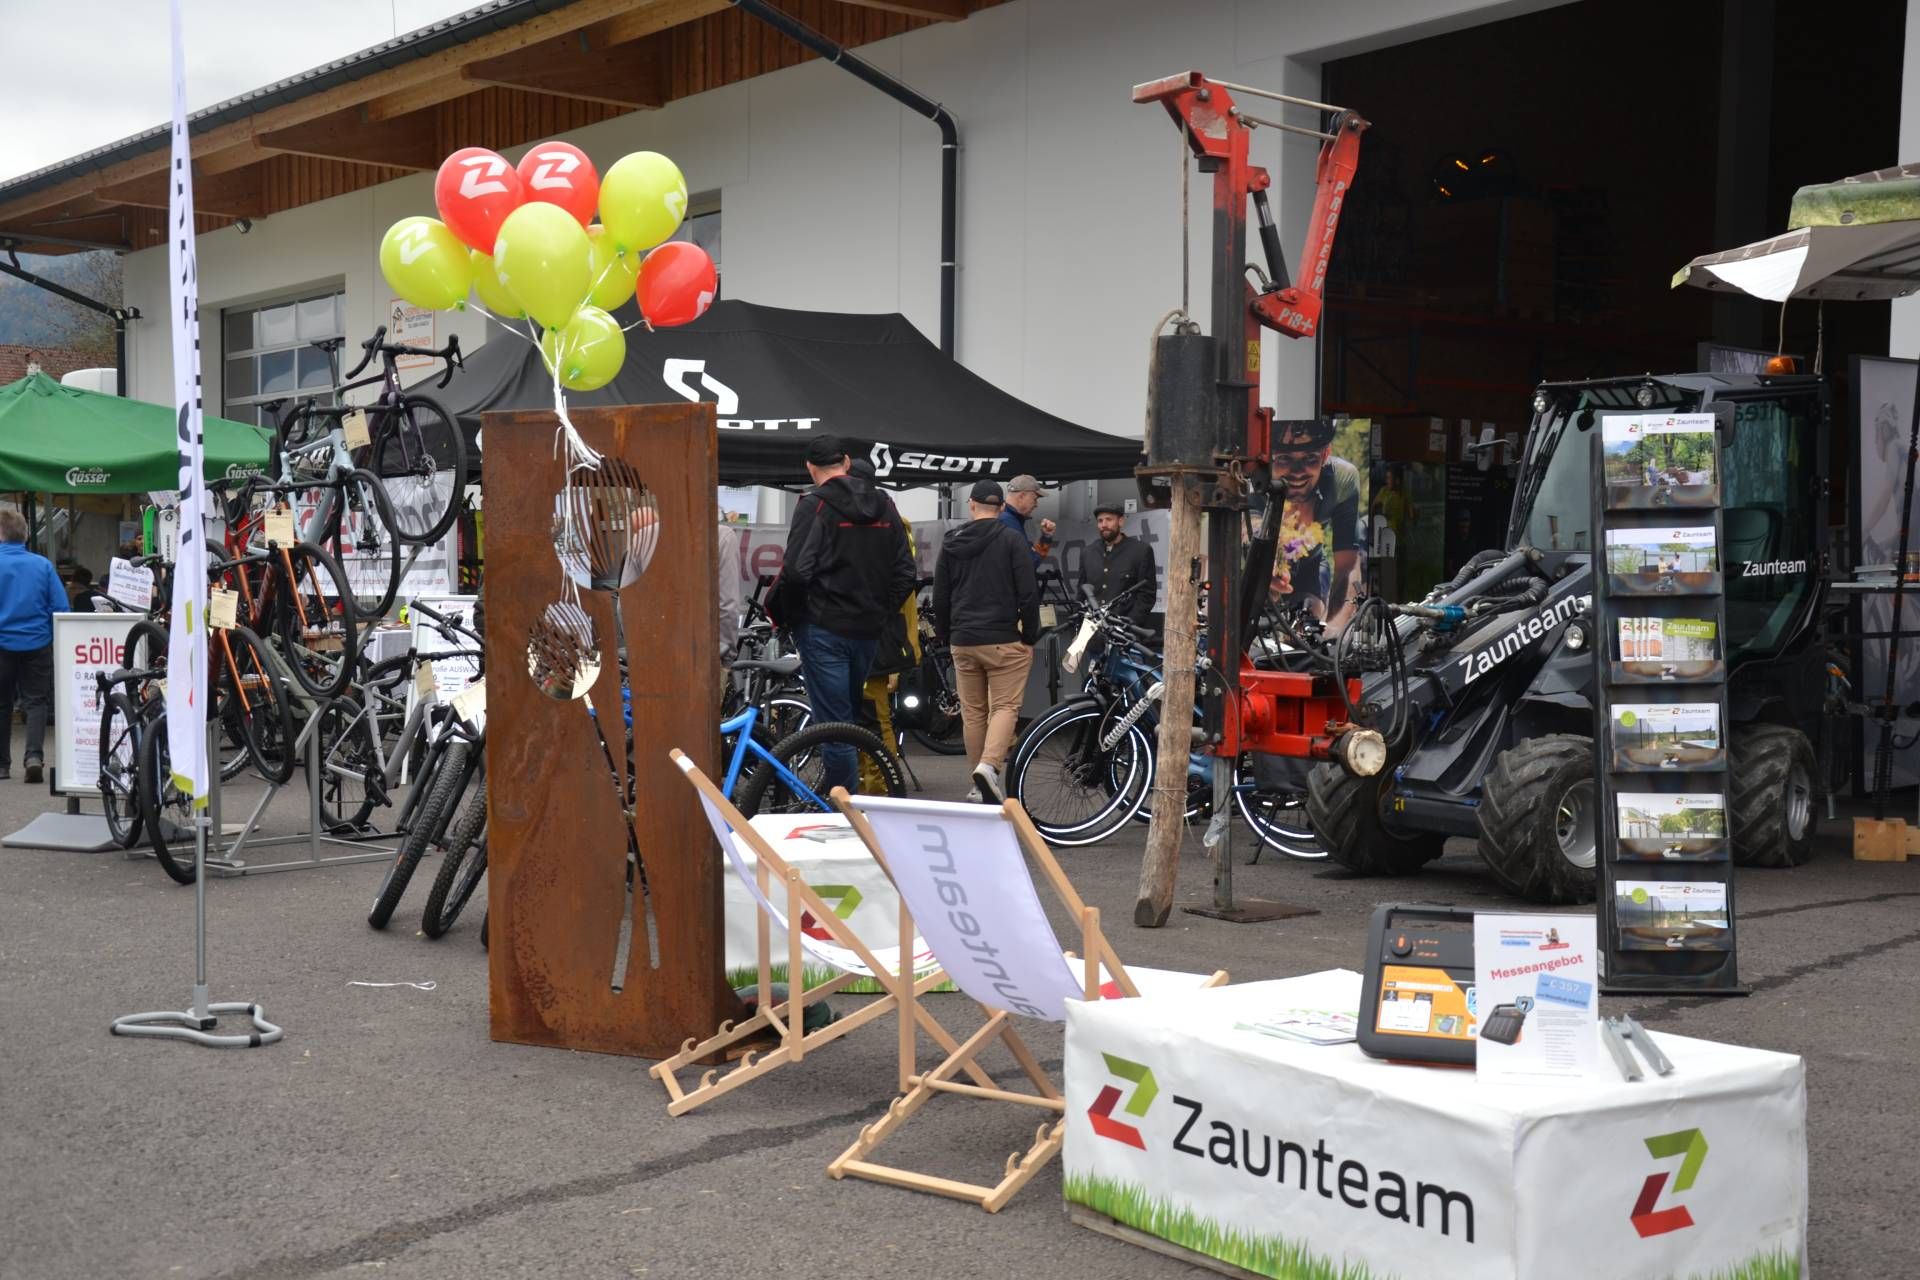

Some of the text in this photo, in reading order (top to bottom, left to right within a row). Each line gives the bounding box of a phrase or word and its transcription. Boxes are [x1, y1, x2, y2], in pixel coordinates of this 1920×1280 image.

[896, 452, 1009, 474] SCOTT
[65, 466, 111, 487] Gösser
[1742, 558, 1807, 577] Zaunteam
[1458, 594, 1585, 685] Zaunteam
[876, 750, 900, 785] MAXXIS
[1490, 954, 1584, 980] Messeangebot
[1172, 1094, 1476, 1244] Zaunteam
